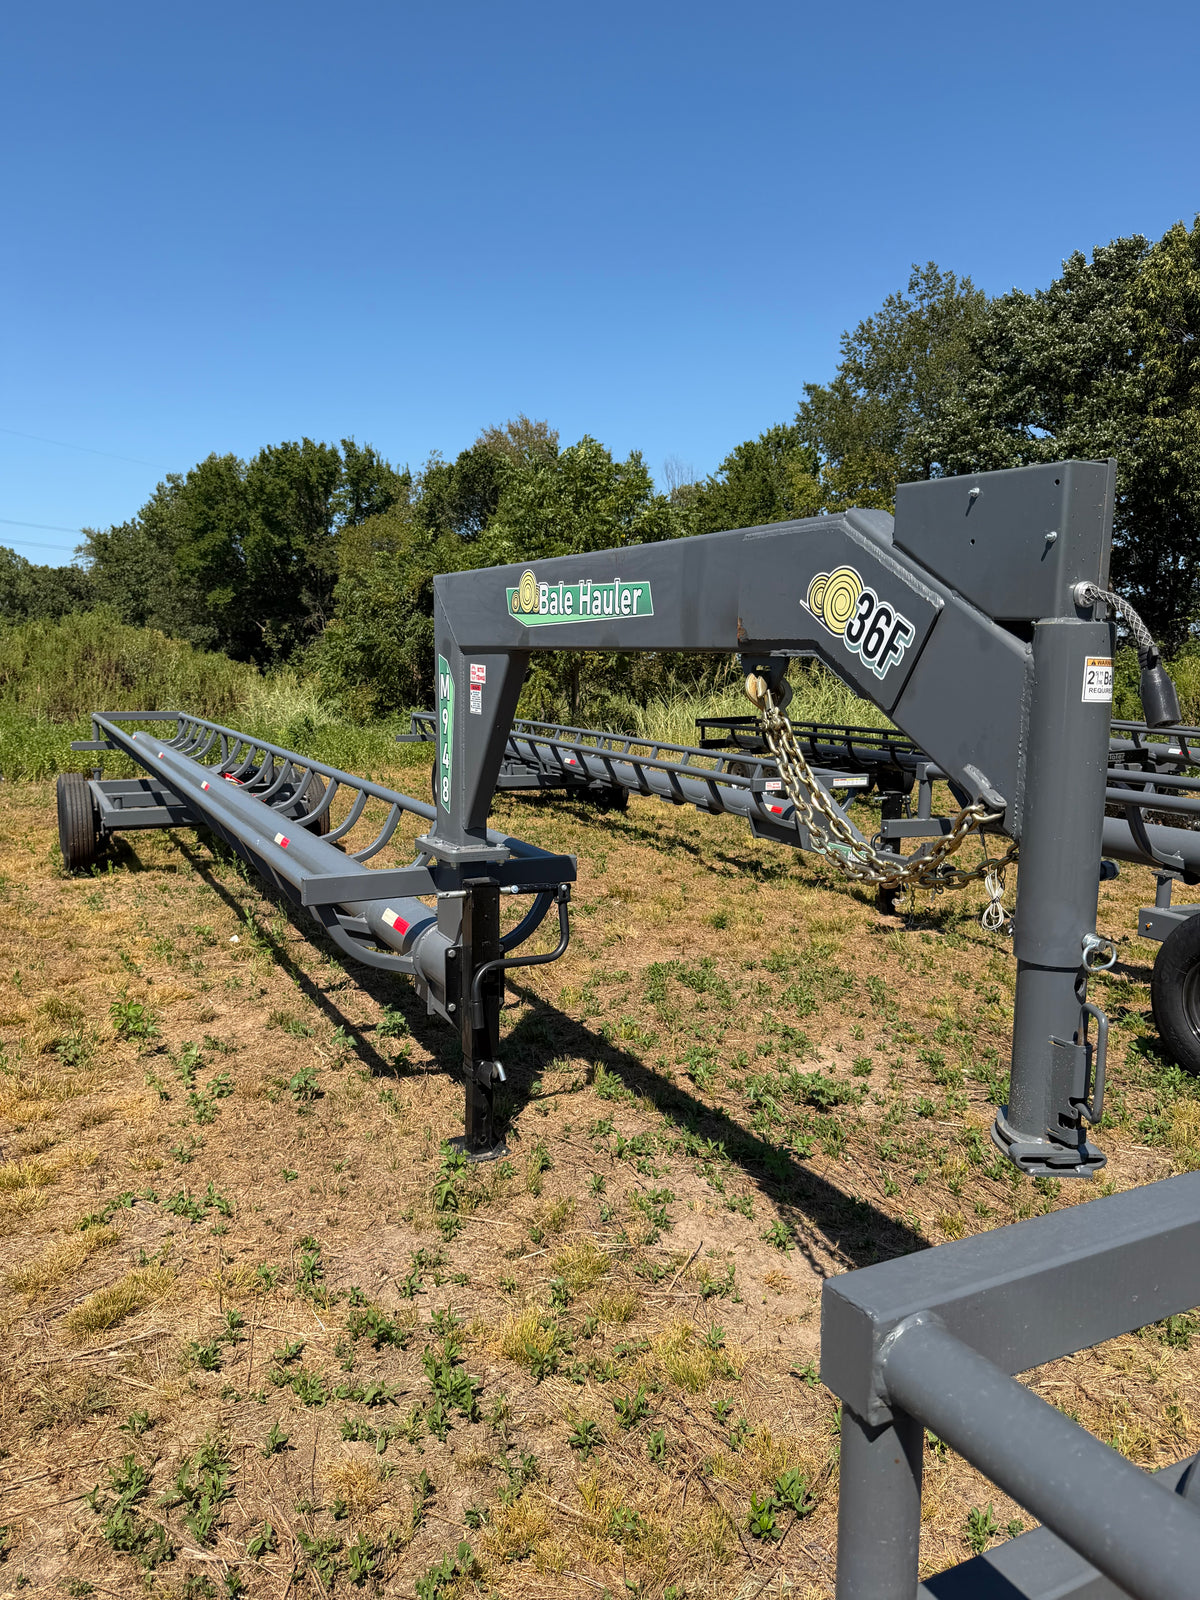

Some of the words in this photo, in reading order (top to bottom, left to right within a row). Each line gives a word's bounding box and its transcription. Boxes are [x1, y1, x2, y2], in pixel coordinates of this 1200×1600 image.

[538, 581, 574, 615] Bale
[578, 578, 643, 616] Hauler
[845, 590, 912, 673] 36F
[440, 673, 450, 803] M948
